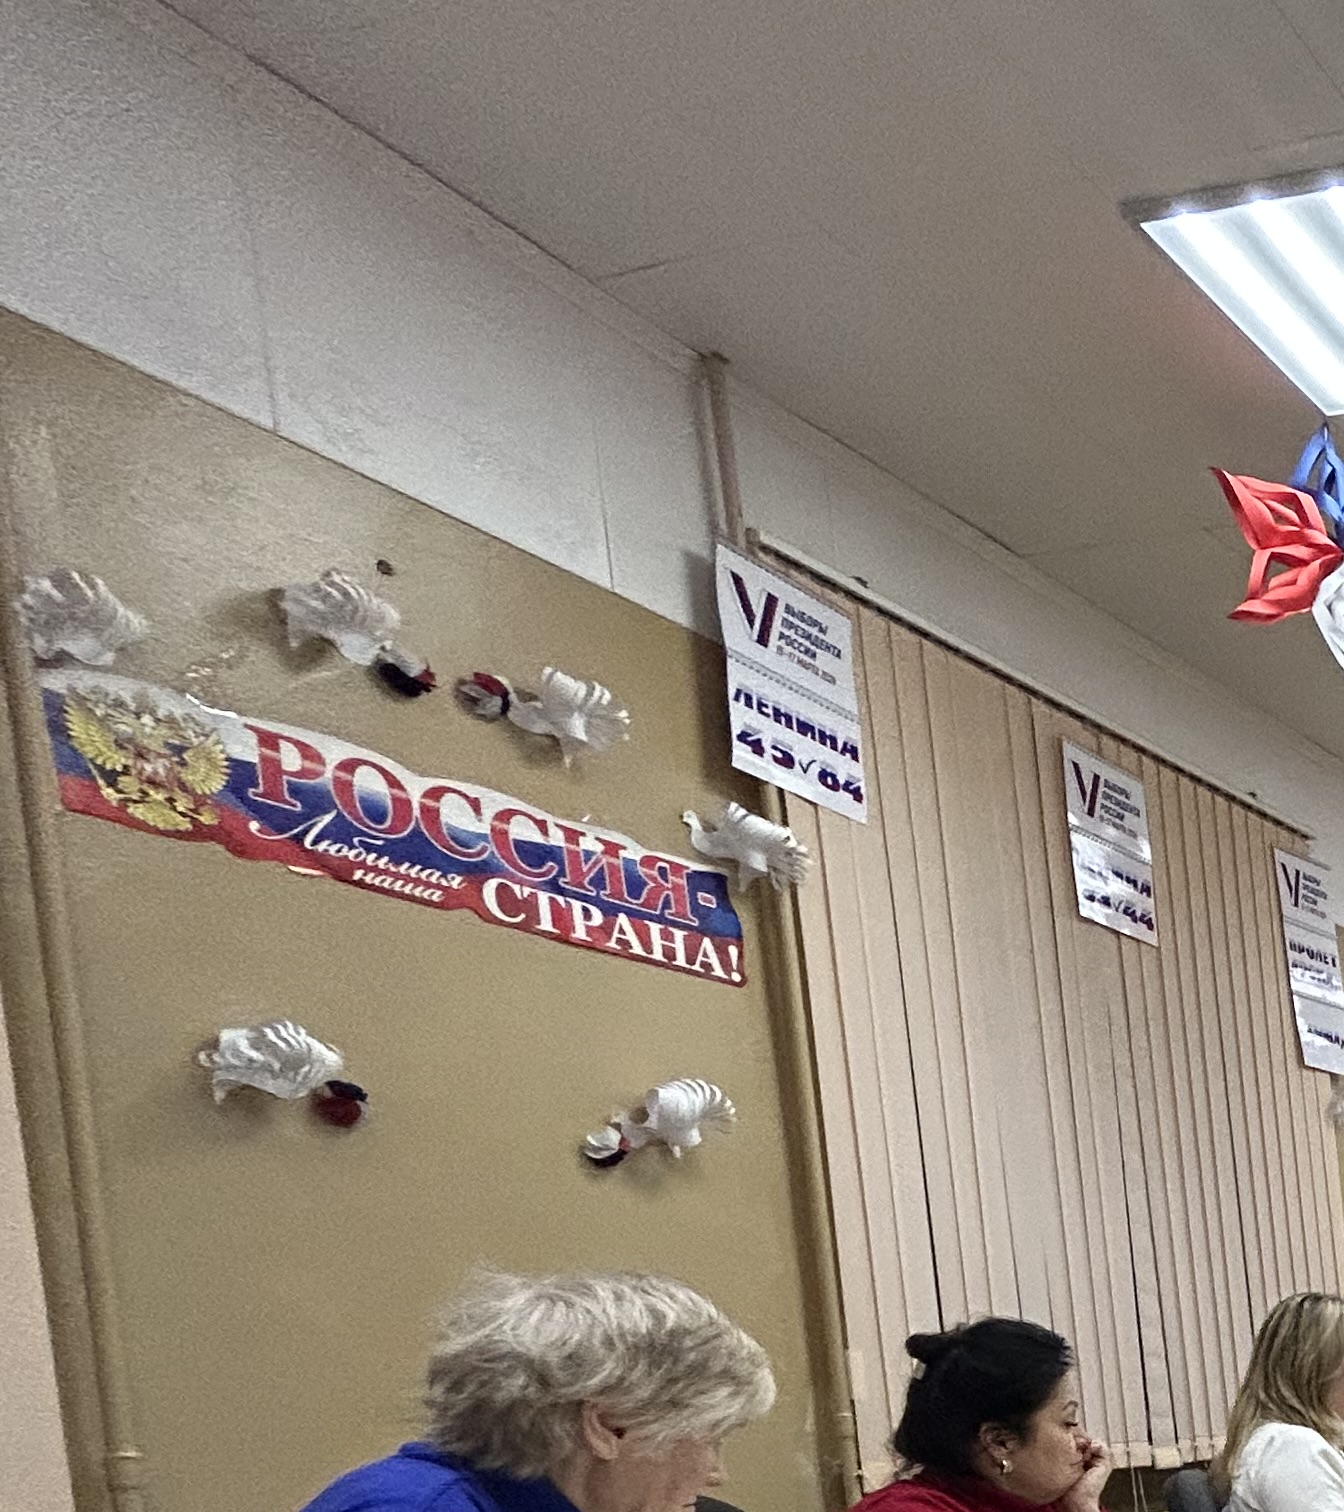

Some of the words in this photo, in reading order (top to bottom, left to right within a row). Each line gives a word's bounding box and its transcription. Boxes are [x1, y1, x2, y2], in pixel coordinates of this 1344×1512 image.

[781, 616, 842, 660] ПРЕЗИДЕНТА
[784, 603, 828, 635] ВЫБОРЫ
[733, 683, 860, 763] ЛЕНИНА
[248, 809, 466, 891] Любимая
[352, 864, 446, 903] наша
[481, 877, 745, 985] СТРАНА!
